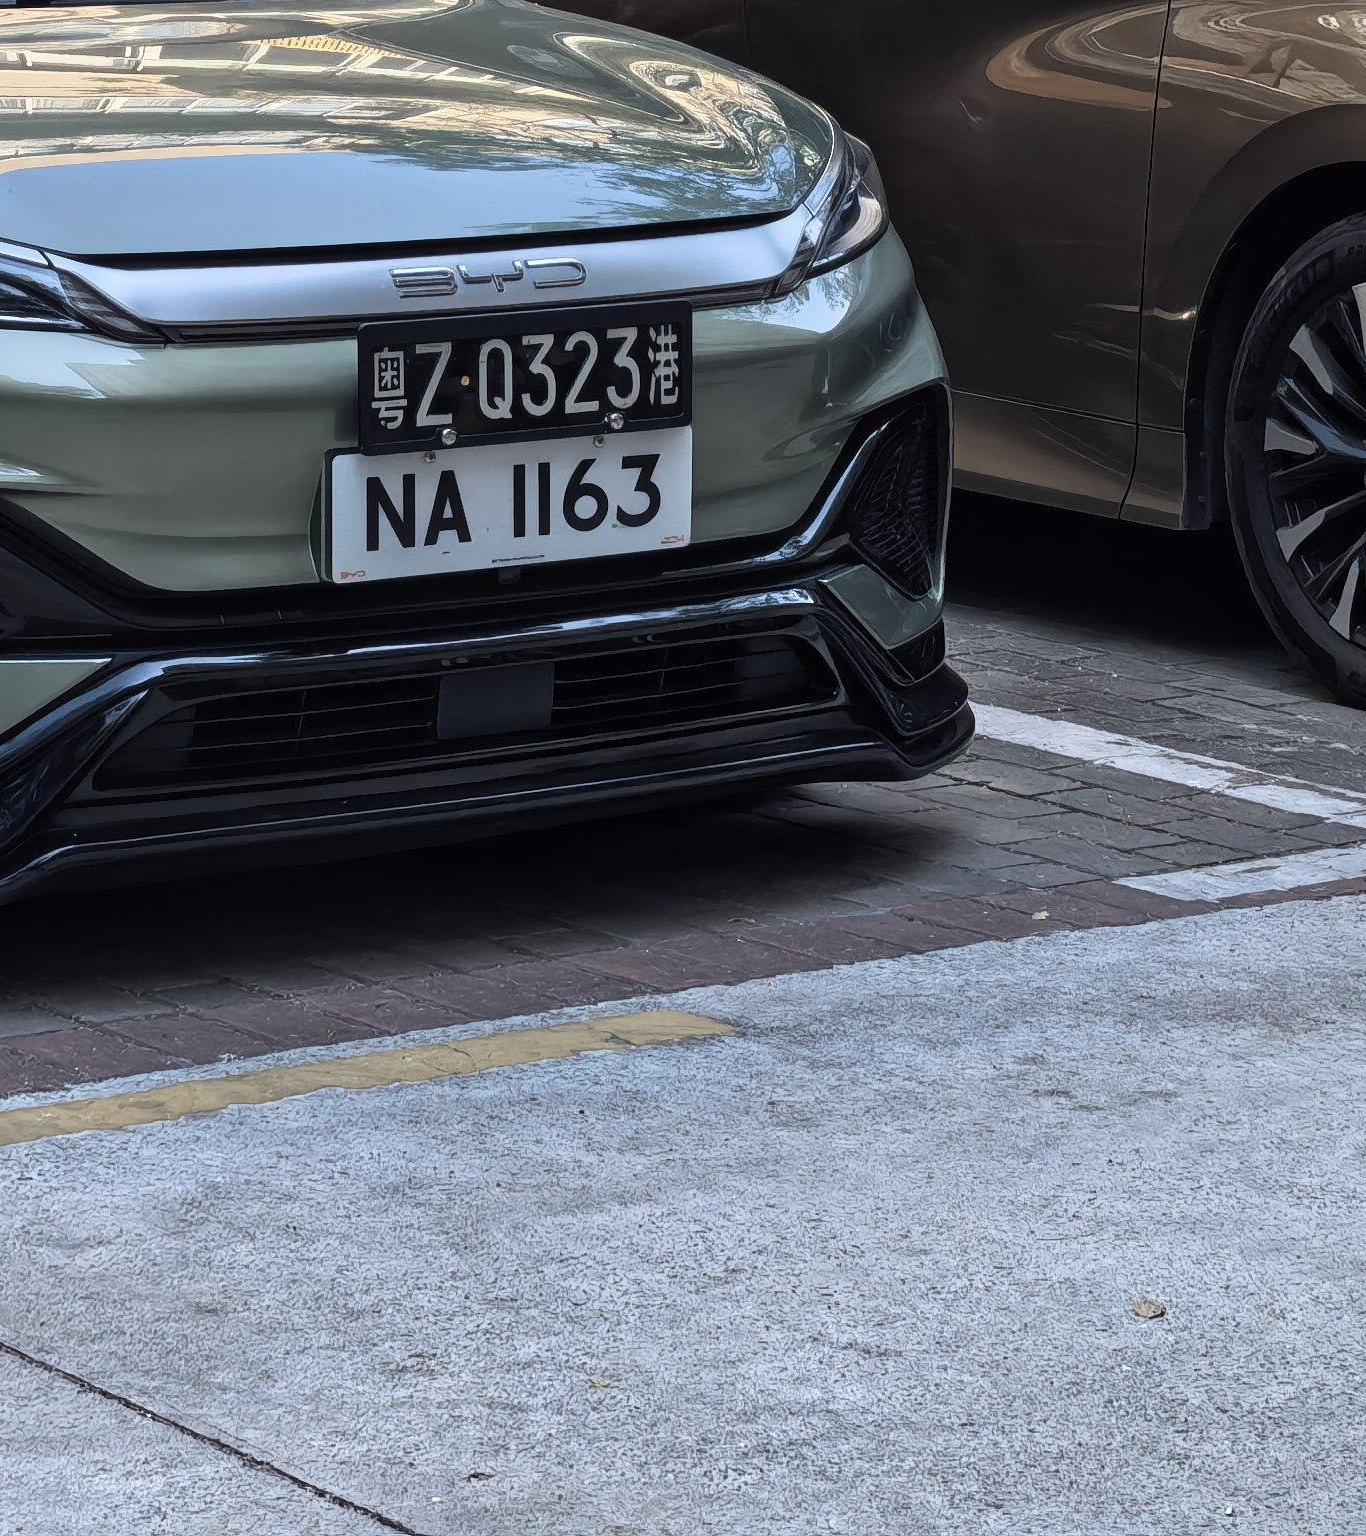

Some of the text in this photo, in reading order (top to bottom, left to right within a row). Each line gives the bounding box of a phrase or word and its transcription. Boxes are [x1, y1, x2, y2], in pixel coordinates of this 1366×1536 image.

[389, 257, 587, 299] BYD
[366, 454, 662, 552] NA 1163
